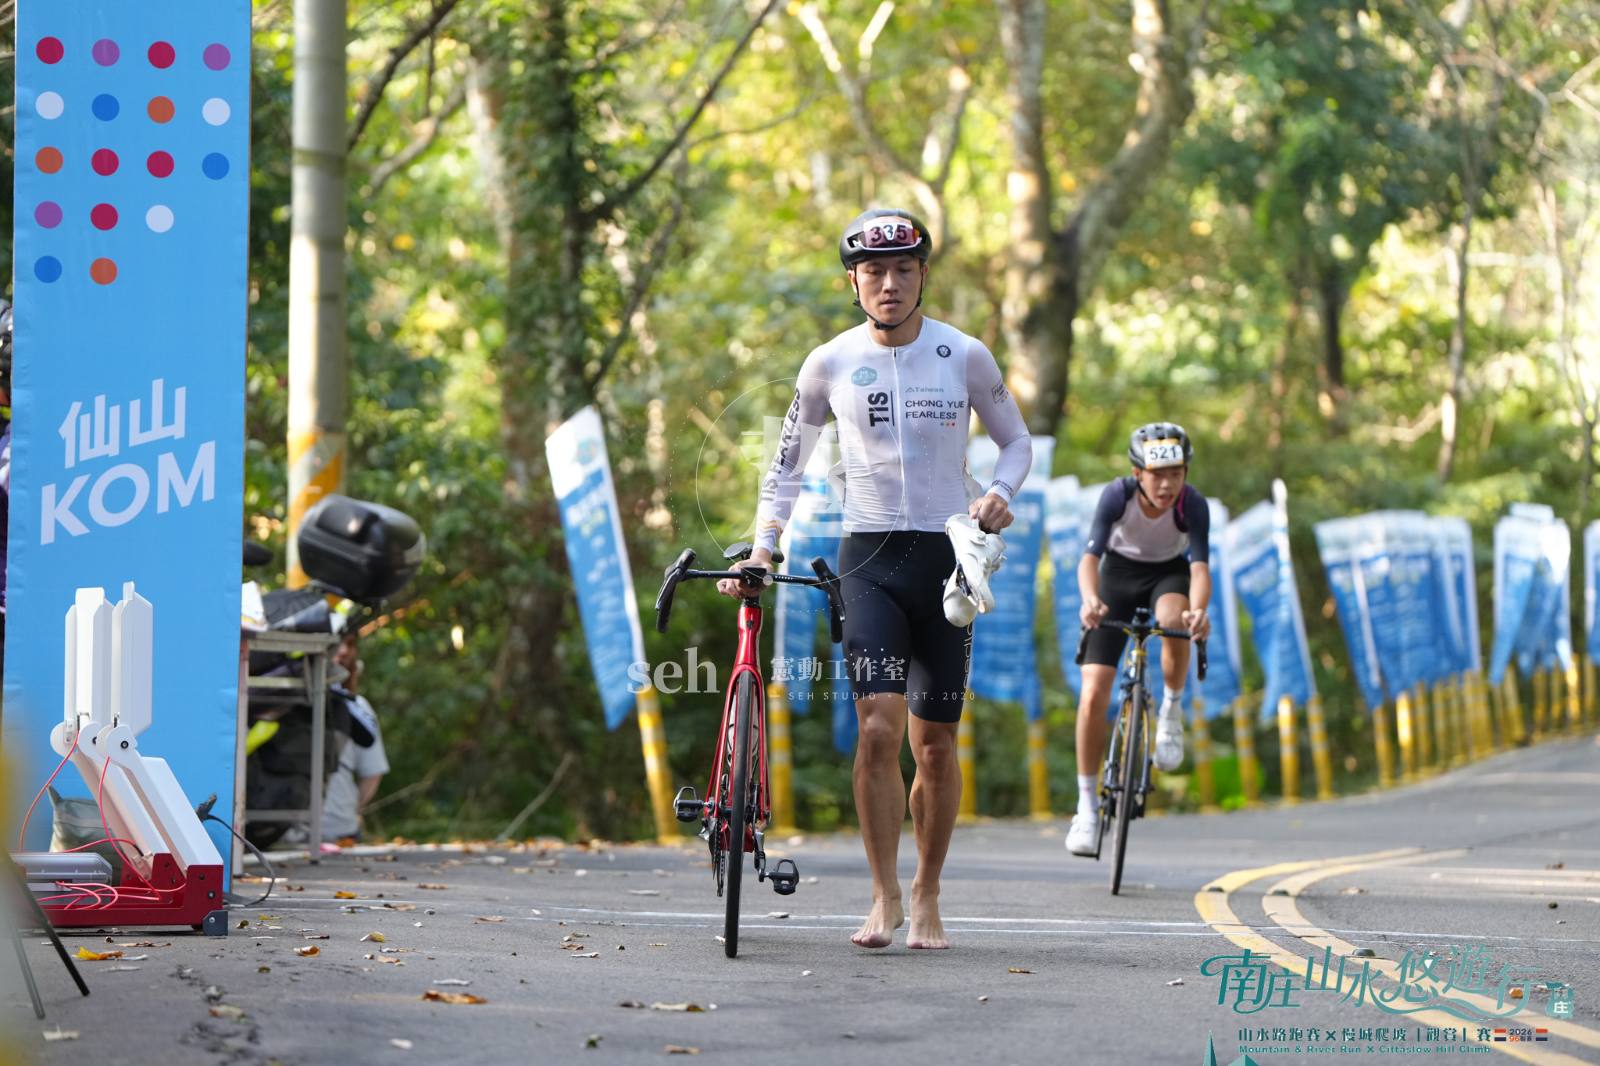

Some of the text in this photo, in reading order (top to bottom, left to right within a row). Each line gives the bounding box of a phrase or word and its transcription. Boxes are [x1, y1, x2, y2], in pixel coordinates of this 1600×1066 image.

[869, 224, 908, 243] 335
[868, 391, 890, 428] TIS
[905, 400, 966, 409] CHONG YUE
[58, 378, 187, 469] 仙山
[905, 410, 958, 420] FEARLESS
[1149, 445, 1178, 461] 521
[40, 440, 216, 545] KOM
